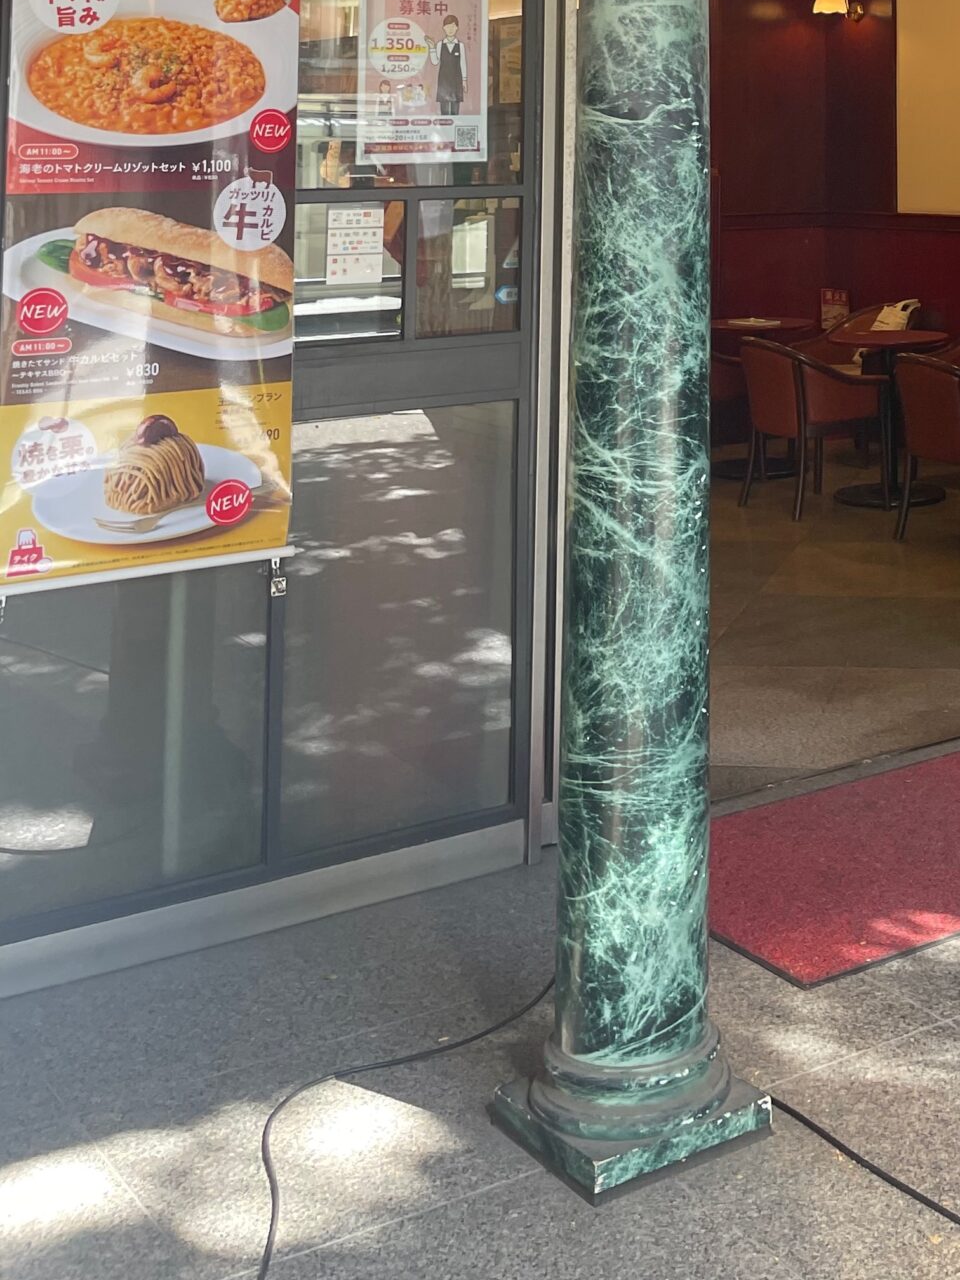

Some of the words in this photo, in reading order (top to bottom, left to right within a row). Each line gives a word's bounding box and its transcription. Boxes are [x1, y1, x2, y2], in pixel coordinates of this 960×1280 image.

[56, 6, 100, 28] 旨み
[399, 0, 449, 16] 募集中
[253, 122, 291, 138] NEW
[19, 160, 186, 174] 海老のトマトクリームリゾットセット
[191, 159, 232, 174] ¥1,100
[222, 202, 259, 241] 牛
[260, 204, 274, 241] カルビ
[20, 303, 67, 320] NEW
[210, 490, 250, 516] NEW
